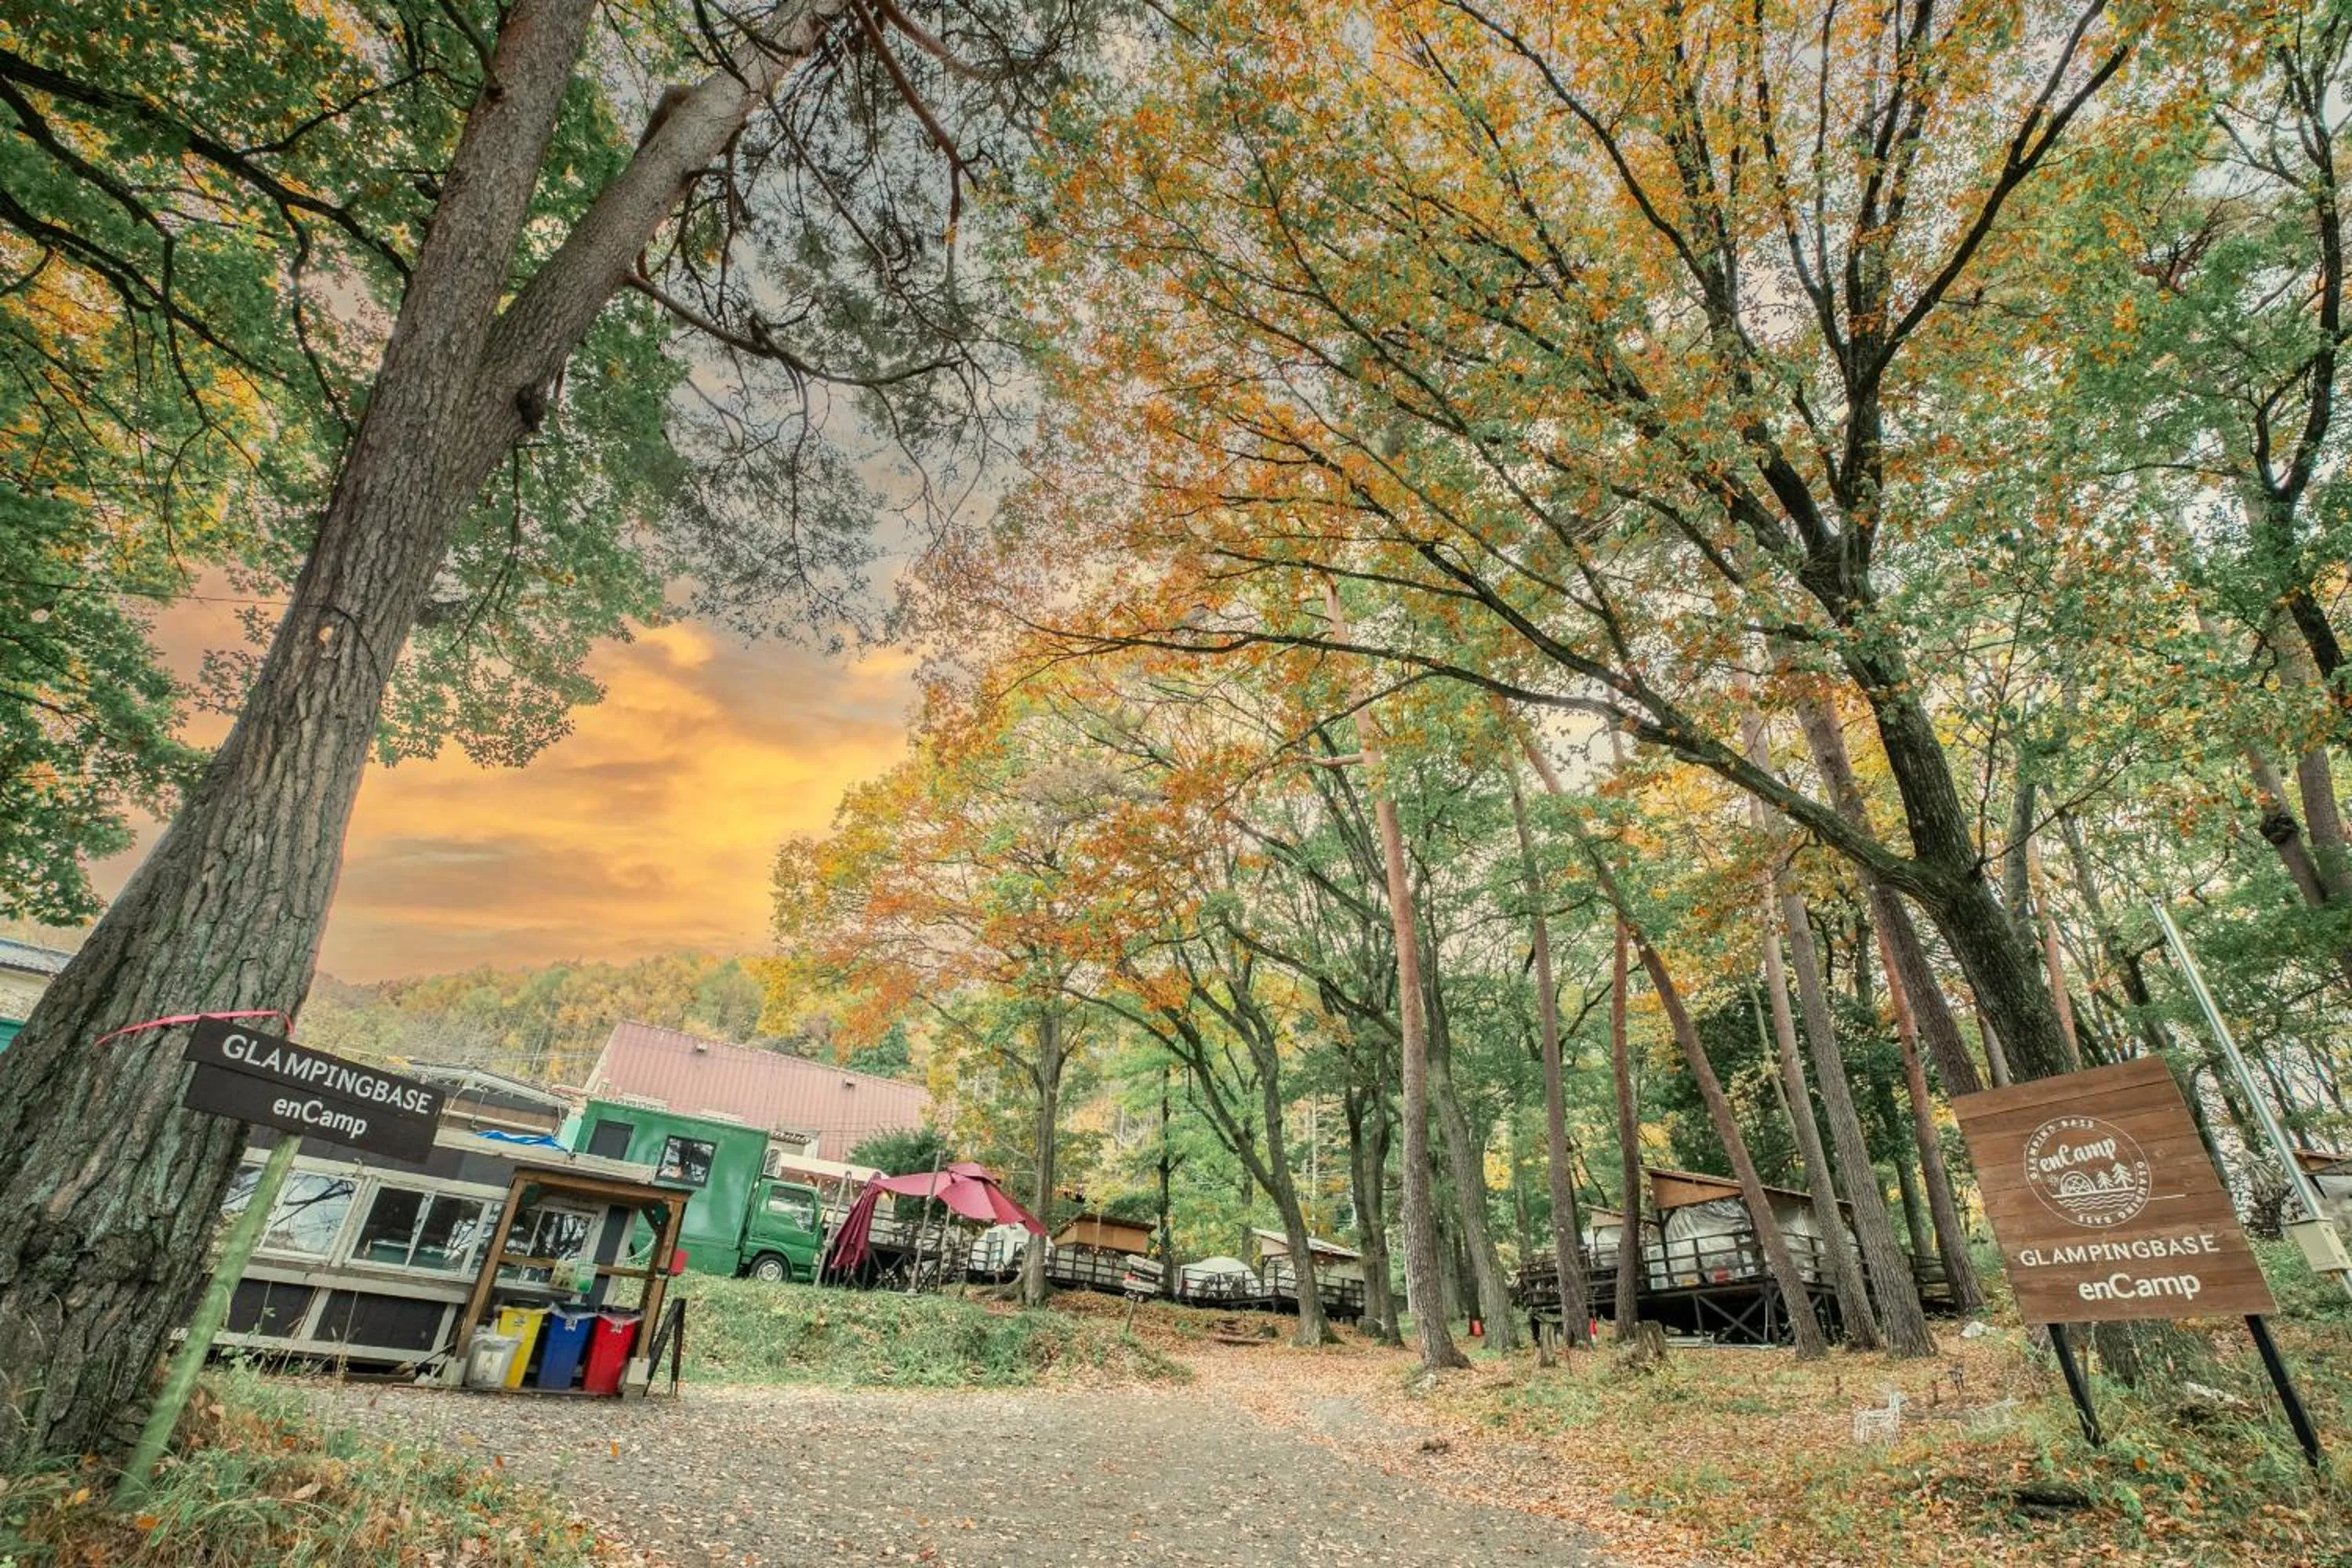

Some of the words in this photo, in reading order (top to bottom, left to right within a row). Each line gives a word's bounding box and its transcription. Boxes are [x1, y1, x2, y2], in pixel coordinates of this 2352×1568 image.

[223, 1033, 433, 1115] GLAMPINGBASE
[272, 1097, 368, 1139] enCamp
[2039, 1136, 2118, 1172] enCamp
[2020, 1233, 2220, 1267] GLAMPINGBASE
[2078, 1272, 2201, 1301] enCamp
